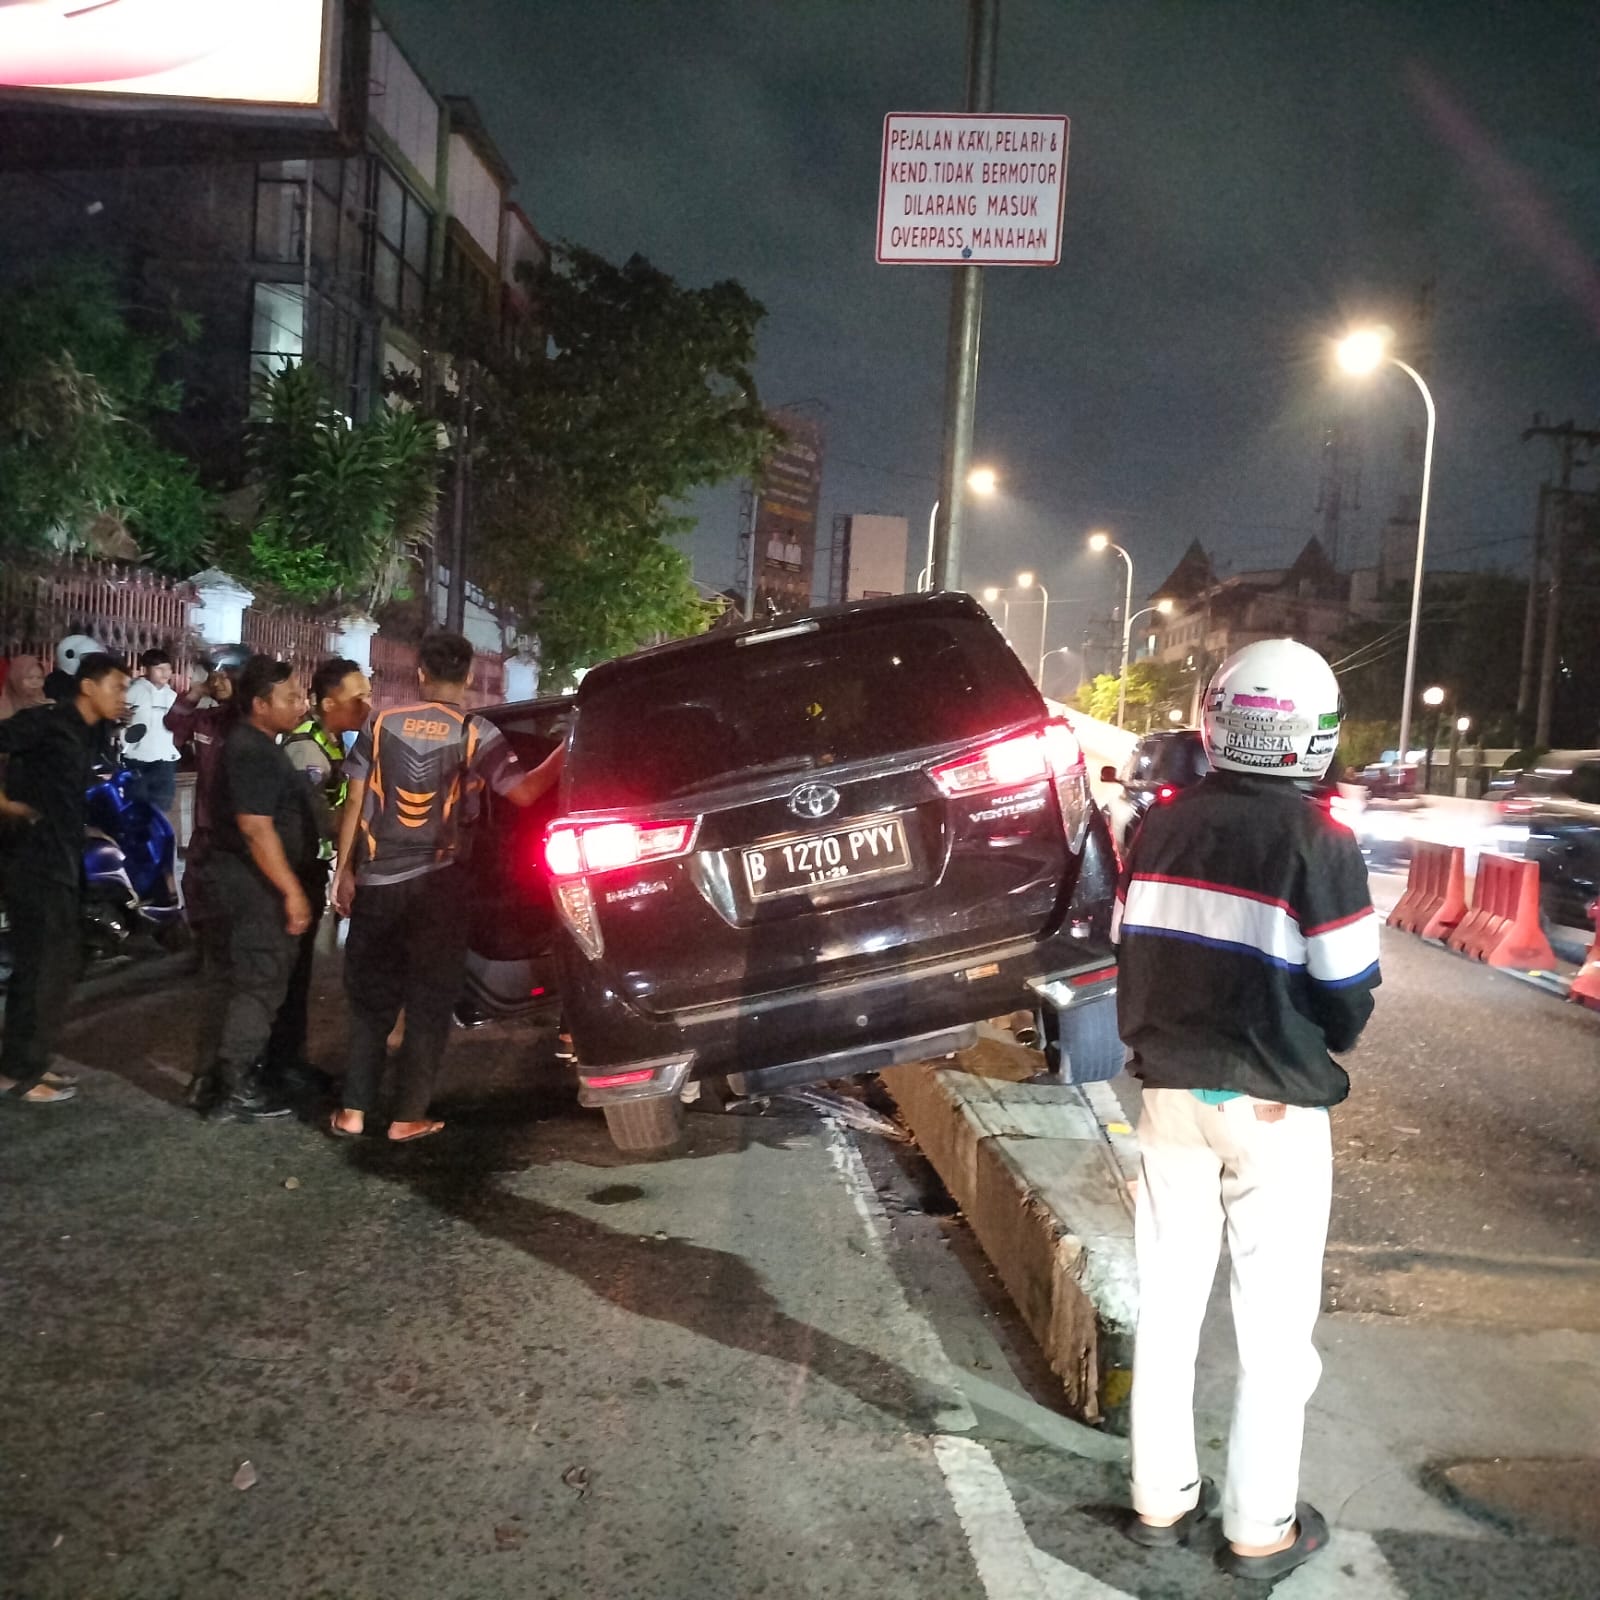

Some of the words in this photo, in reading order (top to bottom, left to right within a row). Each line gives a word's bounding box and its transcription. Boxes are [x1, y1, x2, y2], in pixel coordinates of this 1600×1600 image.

[891, 129, 952, 151] PEJALAN
[1050, 132, 1057, 151] &
[982, 162, 1056, 185] BERMOTOR
[904, 194, 977, 216] DILARANG
[987, 195, 1038, 217] MASUK
[891, 226, 963, 248] OVERPASS
[972, 227, 1047, 249] MANAHAN
[403, 717, 450, 736] BPBD
[749, 852, 767, 882] B
[782, 836, 841, 873] 1270
[848, 825, 894, 861] PYY
